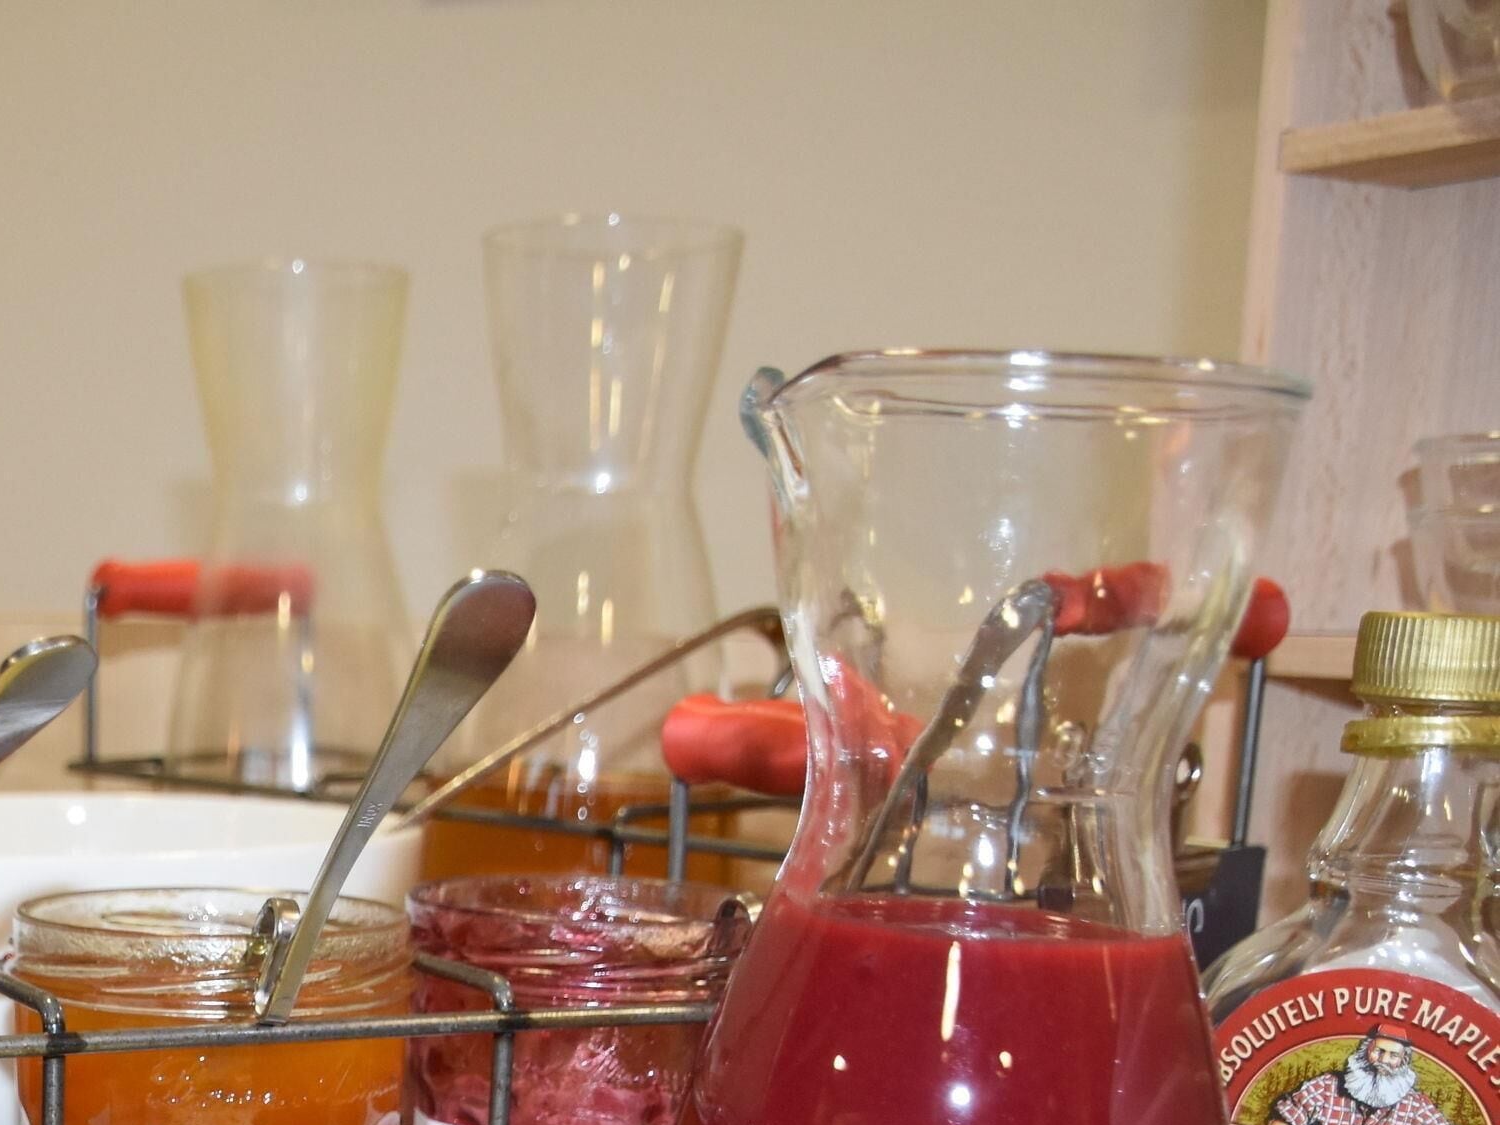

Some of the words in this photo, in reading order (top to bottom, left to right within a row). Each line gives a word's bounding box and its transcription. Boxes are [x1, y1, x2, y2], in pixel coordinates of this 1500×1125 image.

[1218, 989, 1325, 1086] BSOLUTELY
[1333, 986, 1412, 1019] PURE
[1412, 998, 1500, 1071] MAPLE
